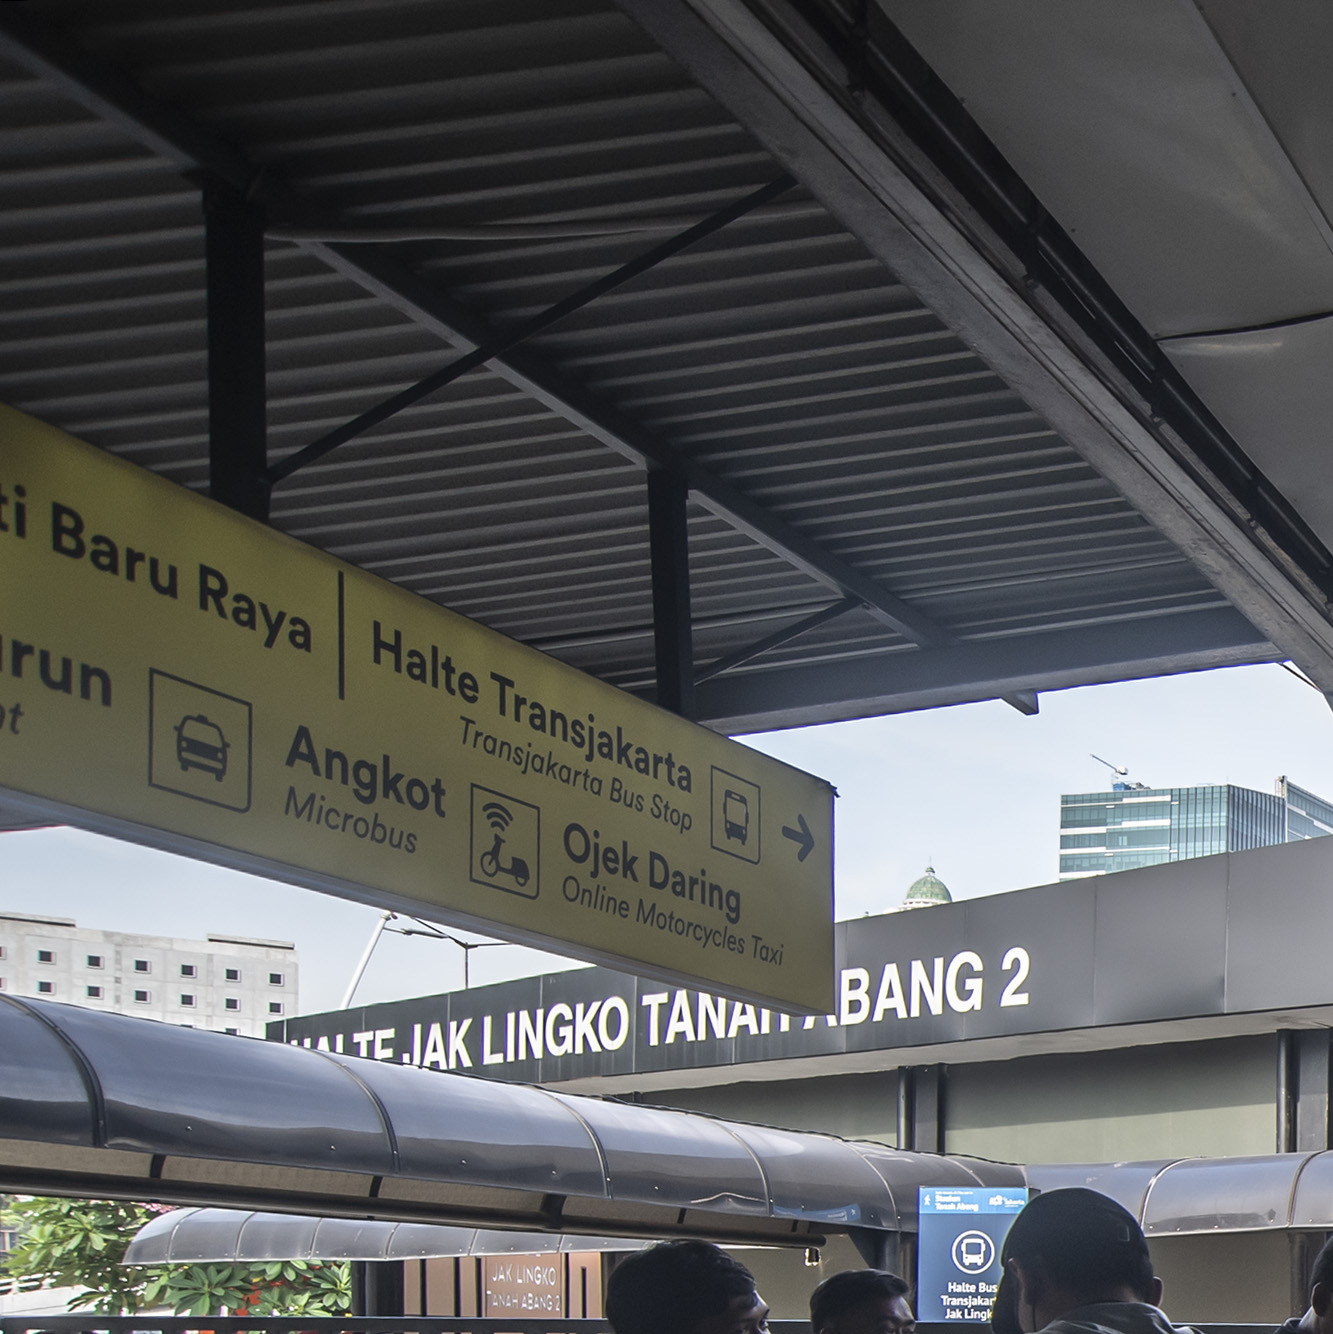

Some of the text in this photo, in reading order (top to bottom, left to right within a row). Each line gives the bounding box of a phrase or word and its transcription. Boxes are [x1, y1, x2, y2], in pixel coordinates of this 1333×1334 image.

[52, 501, 178, 599] Baru
[199, 564, 312, 653] Raya
[0, 634, 111, 707] run
[373, 620, 692, 793] Halte Transjakarta
[285, 725, 446, 818] Angkot
[459, 716, 692, 834] Transjakarta Bus Stop
[284, 785, 417, 853] Microbus
[563, 823, 741, 925] Ojek Daring
[562, 876, 784, 966] Online Motorcycles Taxi
[402, 1018, 473, 1070] JAK
[482, 995, 630, 1066] LINGKO
[1000, 947, 1031, 1007] 2
[492, 1263, 556, 1286] JAK LINGKO
[522, 1293, 553, 1311] ABANG
[555, 1295, 560, 1311] 2
[945, 1309, 962, 1319] Jak
[948, 1282, 998, 1292] Halte Bus
